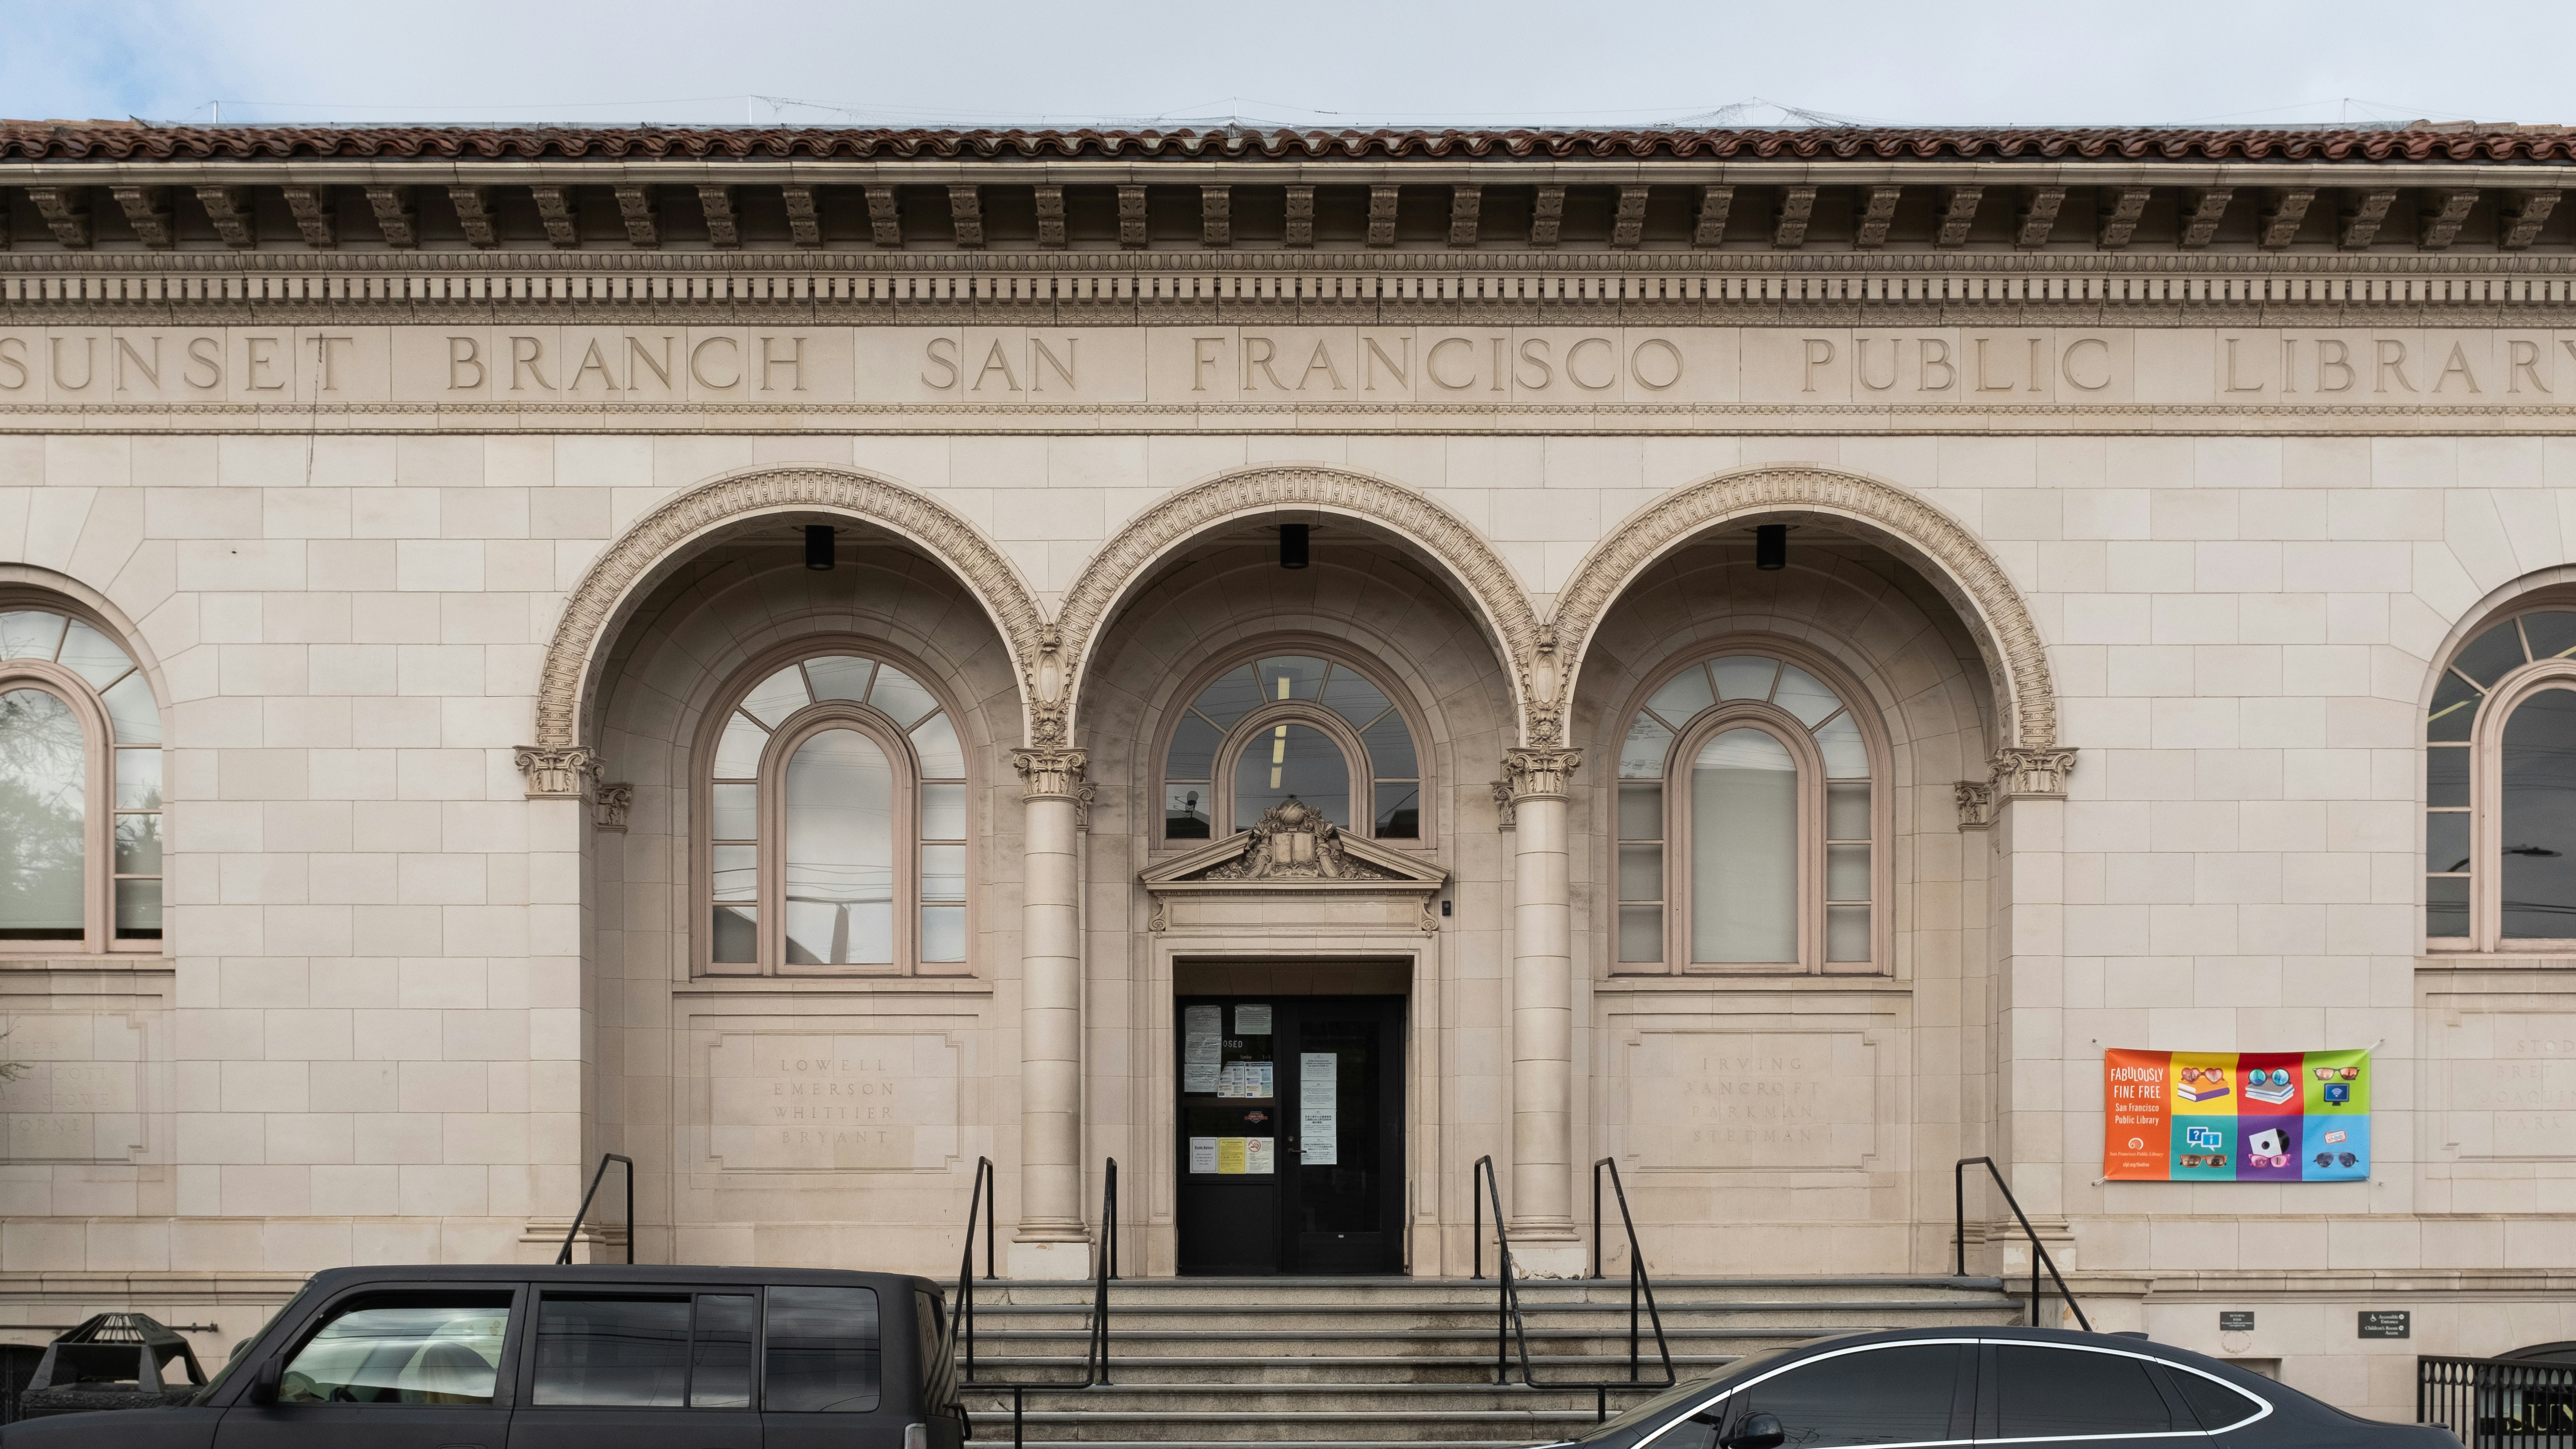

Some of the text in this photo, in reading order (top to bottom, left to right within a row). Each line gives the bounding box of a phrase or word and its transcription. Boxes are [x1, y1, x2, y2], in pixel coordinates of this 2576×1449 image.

[0, 337, 354, 391] SUNSET
[446, 336, 808, 391] BRANCH
[921, 337, 1079, 391] SAN
[1192, 337, 1684, 391] FRANCISCO
[1801, 338, 2112, 392] PUBLIC
[781, 1059, 886, 1071] LOWELL
[1703, 1058, 1801, 1070] IRVING
[2111, 1067, 2163, 1082] FABULOUSLY
[2496, 1065, 2553, 1078] BRET
[774, 1083, 894, 1095] EMERSON
[1684, 1082, 1819, 1095] BANCROFT
[2114, 1086, 2161, 1098] FINE FREE
[773, 1106, 894, 1119] WHITTIER
[1692, 1106, 1812, 1118] PARKMAN
[2115, 1102, 2159, 1112] San Francisco
[2115, 1115, 2159, 1126] Public Library
[782, 1131, 887, 1143] BRYANT
[1693, 1129, 1812, 1142] STEDMAN
